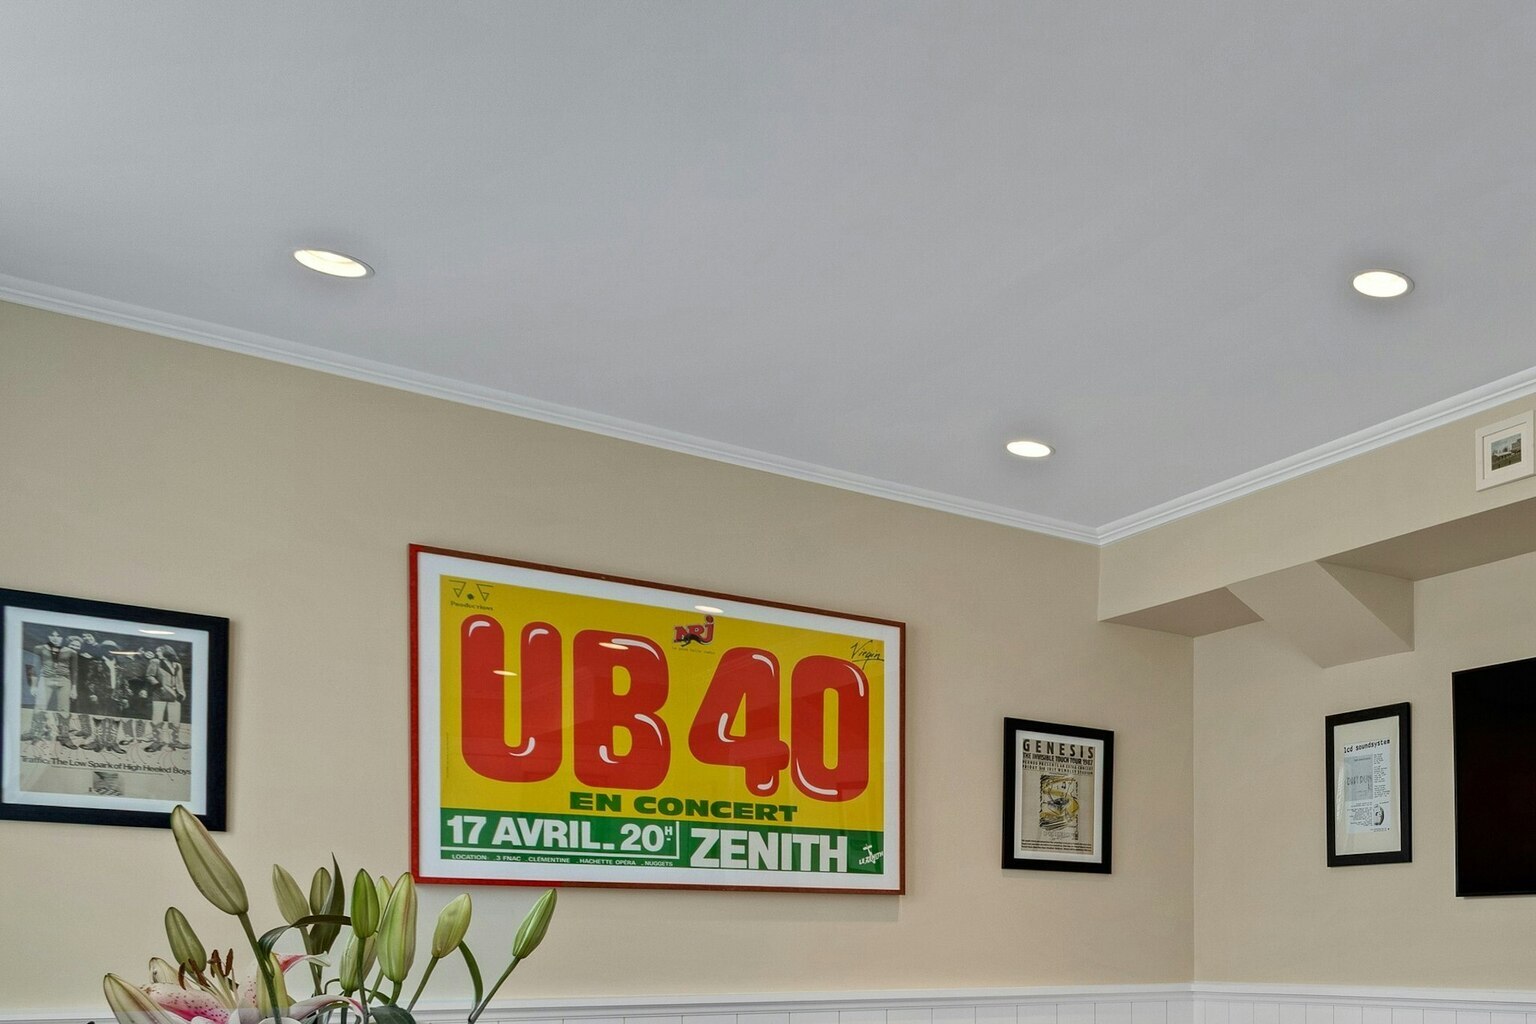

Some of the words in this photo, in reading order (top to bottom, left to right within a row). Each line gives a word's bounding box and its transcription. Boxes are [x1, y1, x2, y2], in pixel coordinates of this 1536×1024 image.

[460, 614, 671, 790] UB
[688, 647, 870, 802] 40
[1023, 739, 1094, 758] GENESIS
[50, 757, 68, 766] The
[69, 759, 86, 767] Low
[88, 760, 112, 769] Spark
[123, 764, 142, 772] High
[143, 765, 171, 774] Heeled
[173, 766, 192, 776] Boys
[569, 791, 621, 812] EN
[634, 796, 798, 823] CONCERT
[447, 815, 487, 844] 17
[690, 828, 848, 873] ZENITH
